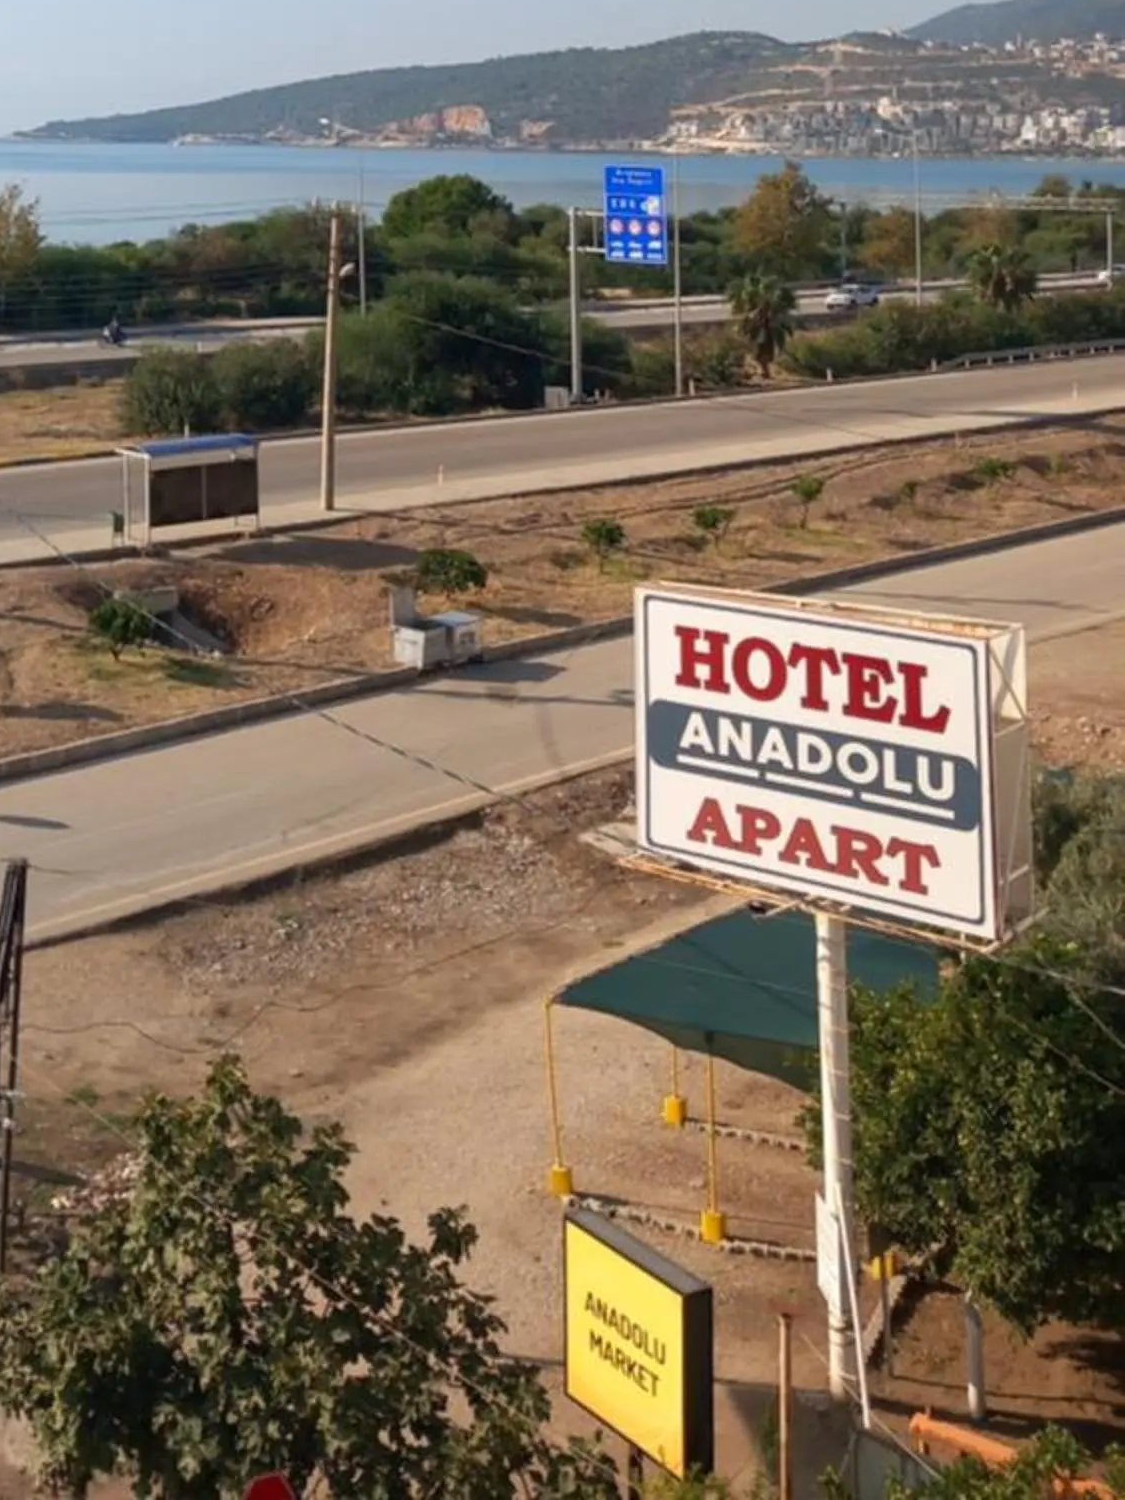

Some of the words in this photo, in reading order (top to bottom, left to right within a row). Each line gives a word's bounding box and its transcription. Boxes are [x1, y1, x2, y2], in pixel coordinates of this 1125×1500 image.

[674, 625, 950, 734] HOTEL
[679, 711, 955, 800] ANADOLU
[687, 797, 941, 894] APART
[585, 1291, 666, 1364] ANADOLU
[589, 1329, 660, 1397] MARKET
